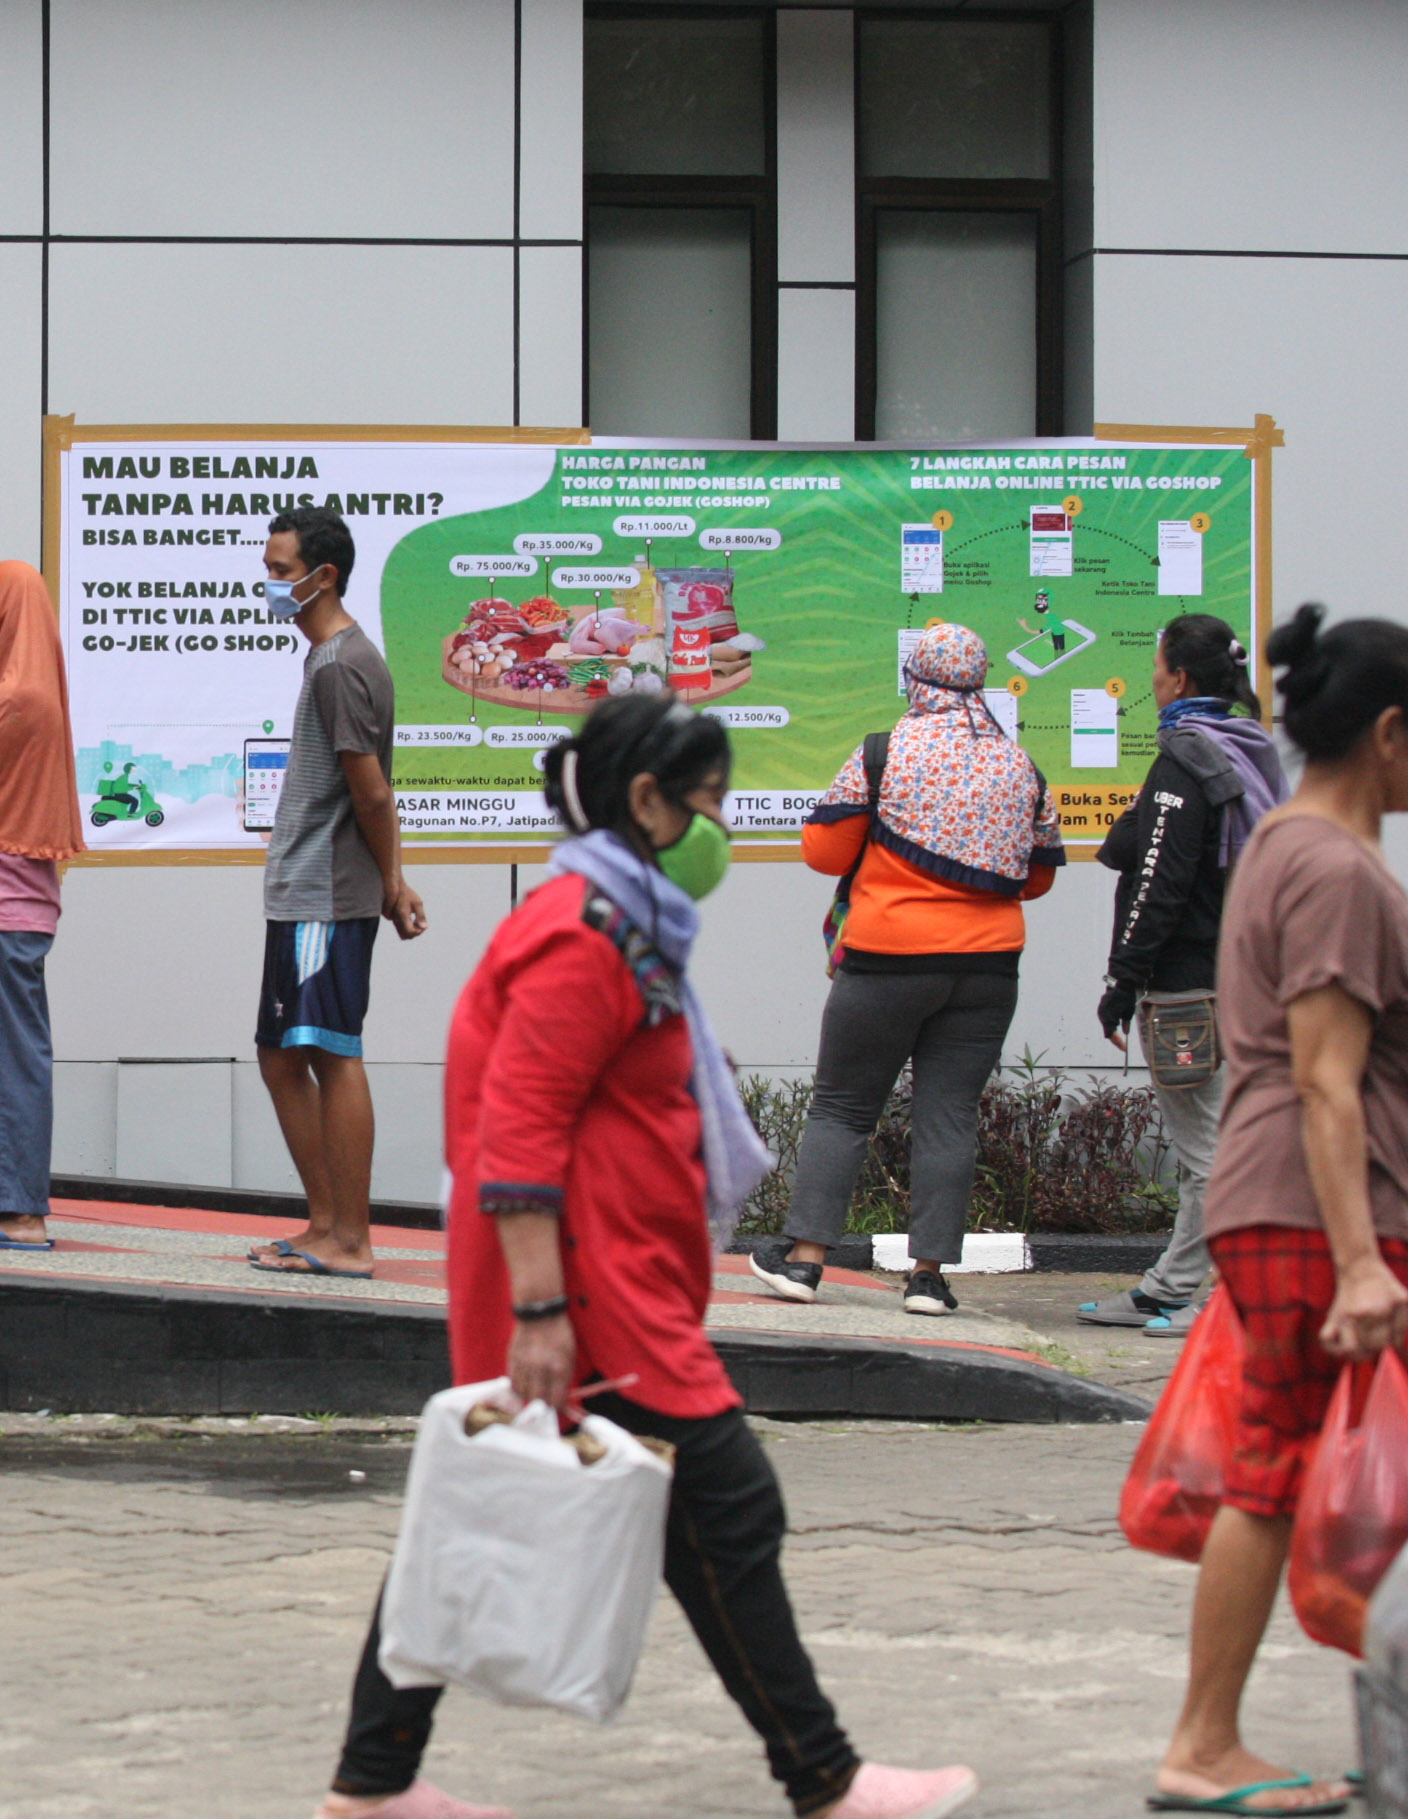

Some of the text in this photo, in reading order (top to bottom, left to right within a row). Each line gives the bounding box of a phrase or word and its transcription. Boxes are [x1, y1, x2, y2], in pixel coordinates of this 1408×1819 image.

[83, 457, 319, 479] MAU BELANJA
[562, 456, 706, 470] HARGA PANGAN
[910, 456, 1126, 470] 7 LANGKAH CARA PESAN
[562, 476, 841, 490] TOKO TANI INDONESIA CENTRE
[910, 476, 1222, 490] BELANJA ONLINE TTIC VIA GOSHOP
[82, 492, 444, 515] TANPA HARUS ANTRI?
[562, 496, 770, 509] PESAN VIA GOJEK (GOSHOP)
[1068, 502, 1076, 511] 2
[621, 522, 688, 532] Rp.11.000/Lt
[939, 517, 945, 526] 1
[1197, 519, 1203, 528] 3
[83, 529, 137, 545] BISA
[708, 535, 772, 545] Rp.8.800/kg
[522, 541, 593, 551] Rp.35.000/Kg
[457, 562, 530, 572] Rp. 75.000/Kg
[561, 574, 632, 584] Rp.30.000/Kg
[82, 582, 132, 598] YOK
[138, 582, 246, 598] BELANJA
[83, 609, 107, 624] DI
[113, 609, 168, 624] TTIC
[173, 609, 214, 624] VIA
[175, 635, 218, 654] (GO
[224, 635, 298, 654] SHOP)
[1013, 682, 1020, 691] 6
[1112, 684, 1119, 693] 5
[729, 713, 781, 723] 12.500/Kg
[397, 731, 471, 742] Rp. 23.500/Kg
[492, 733, 508, 743] Rp.
[406, 776, 490, 785] sewaktu-waktu
[494, 776, 525, 787] dapat
[447, 798, 516, 811] MINGGU
[735, 798, 771, 810] TTIC
[1061, 793, 1102, 806] Buka
[400, 816, 455, 828] Ragunan
[460, 815, 502, 827] No.P7,
[748, 816, 796, 826] Tentara
